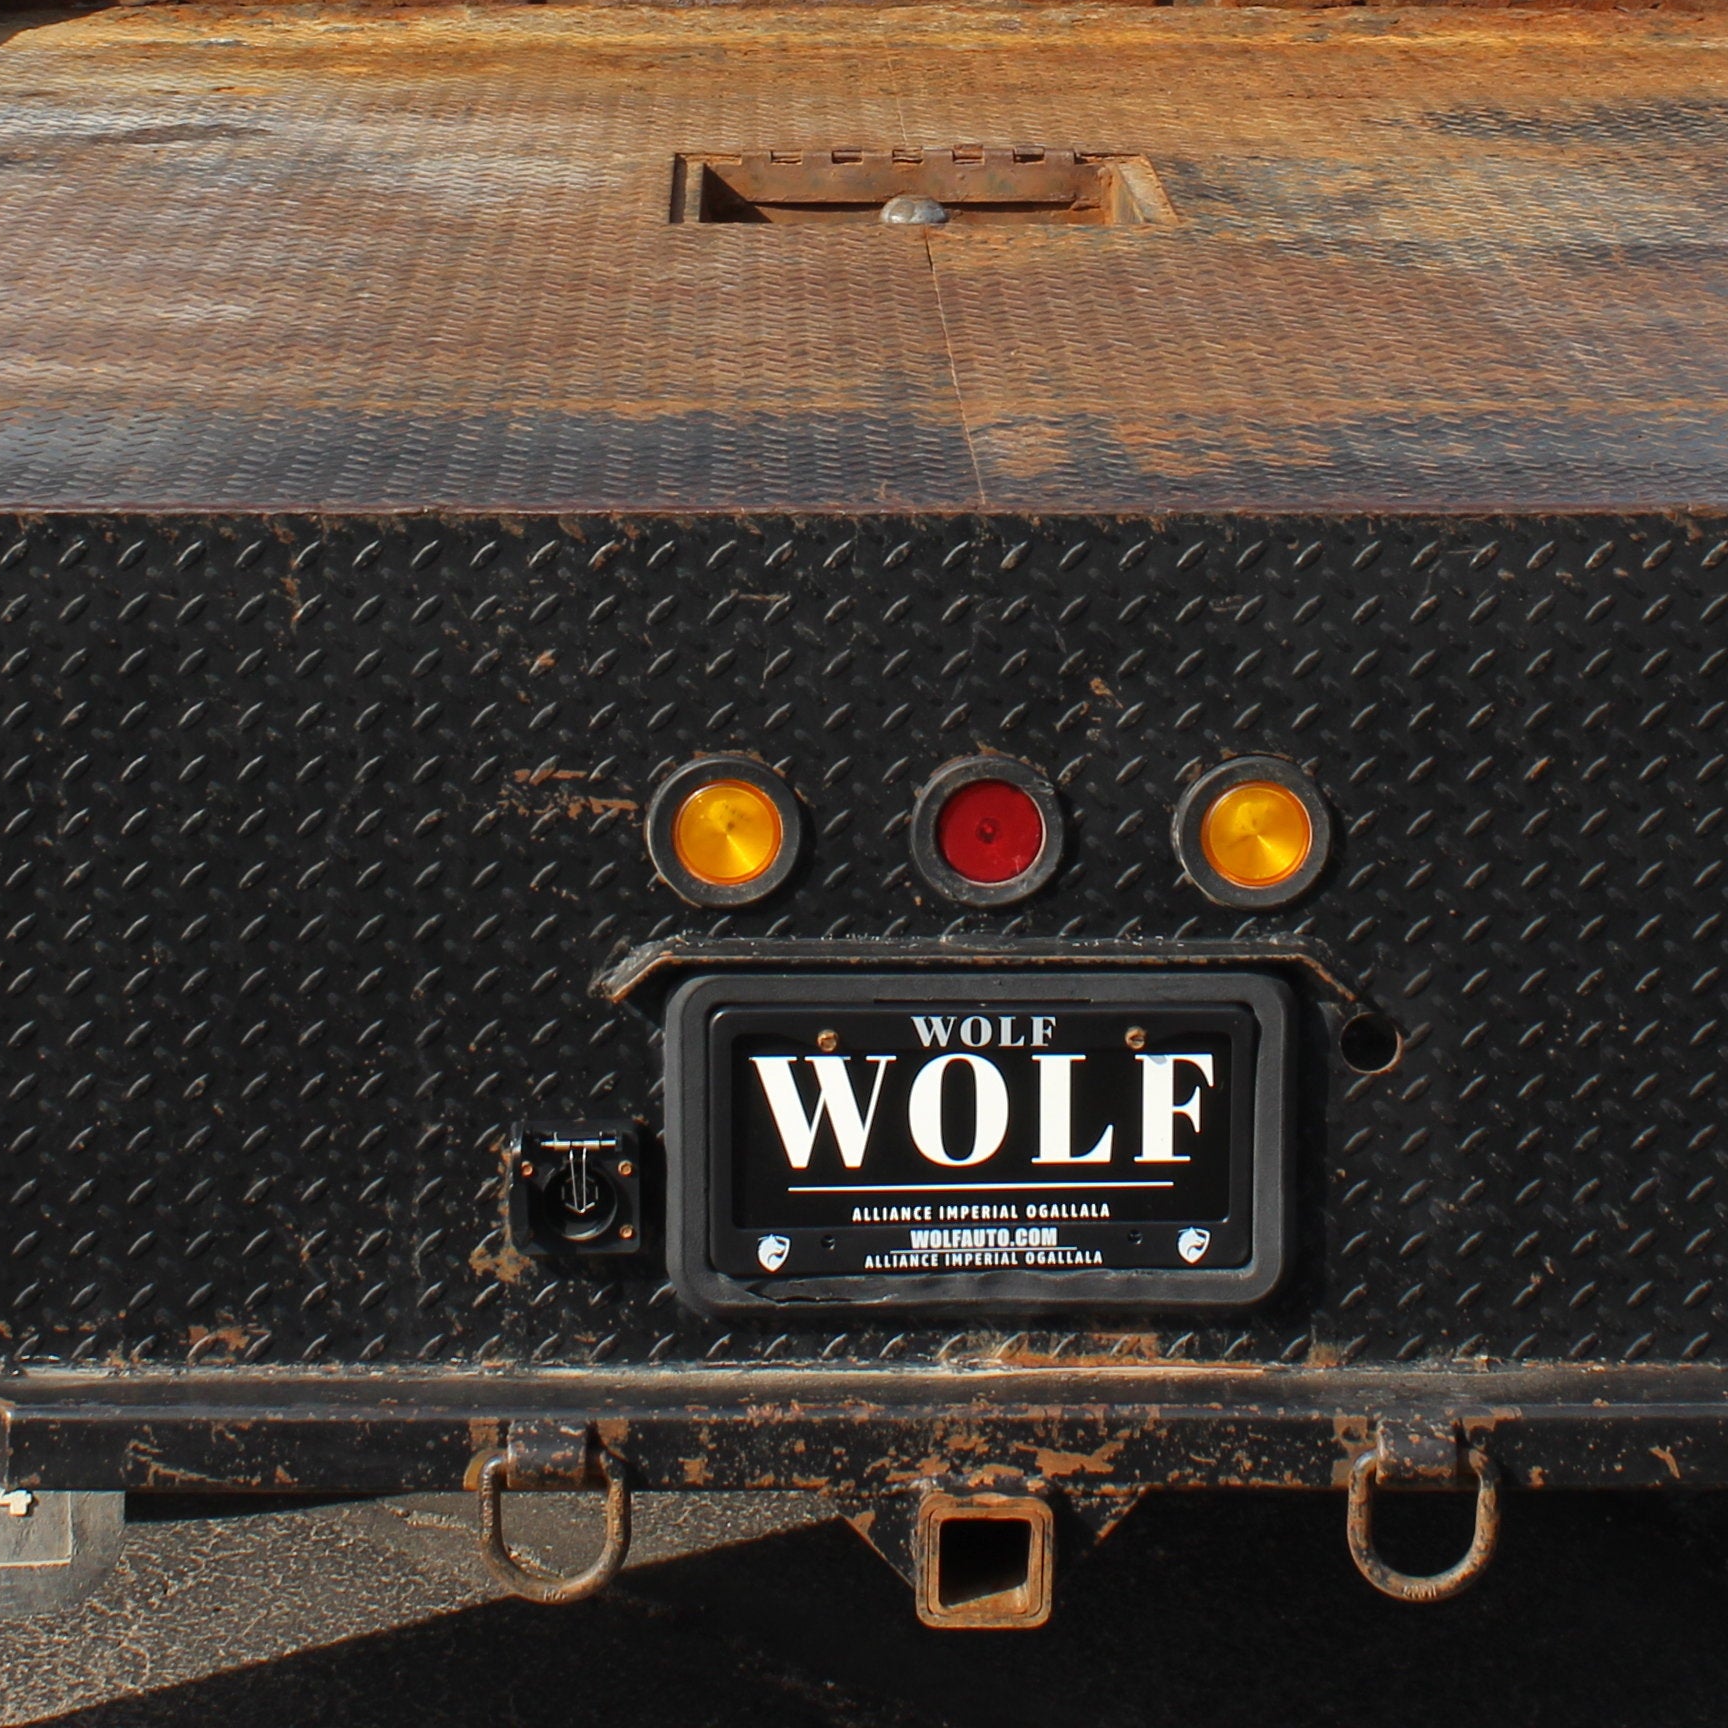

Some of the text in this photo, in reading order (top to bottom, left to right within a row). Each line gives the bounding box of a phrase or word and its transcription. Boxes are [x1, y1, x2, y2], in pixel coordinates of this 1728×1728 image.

[910, 1016, 1057, 1047] WOLF
[748, 1053, 1215, 1169] WOLF
[852, 1203, 1111, 1222] ALLIANCE IMPERIAL OGALLALA
[910, 1227, 1058, 1249] WOLFAUTO.COM
[864, 1250, 1103, 1269] ALLIANCE IMPERIAL OGALLALA
